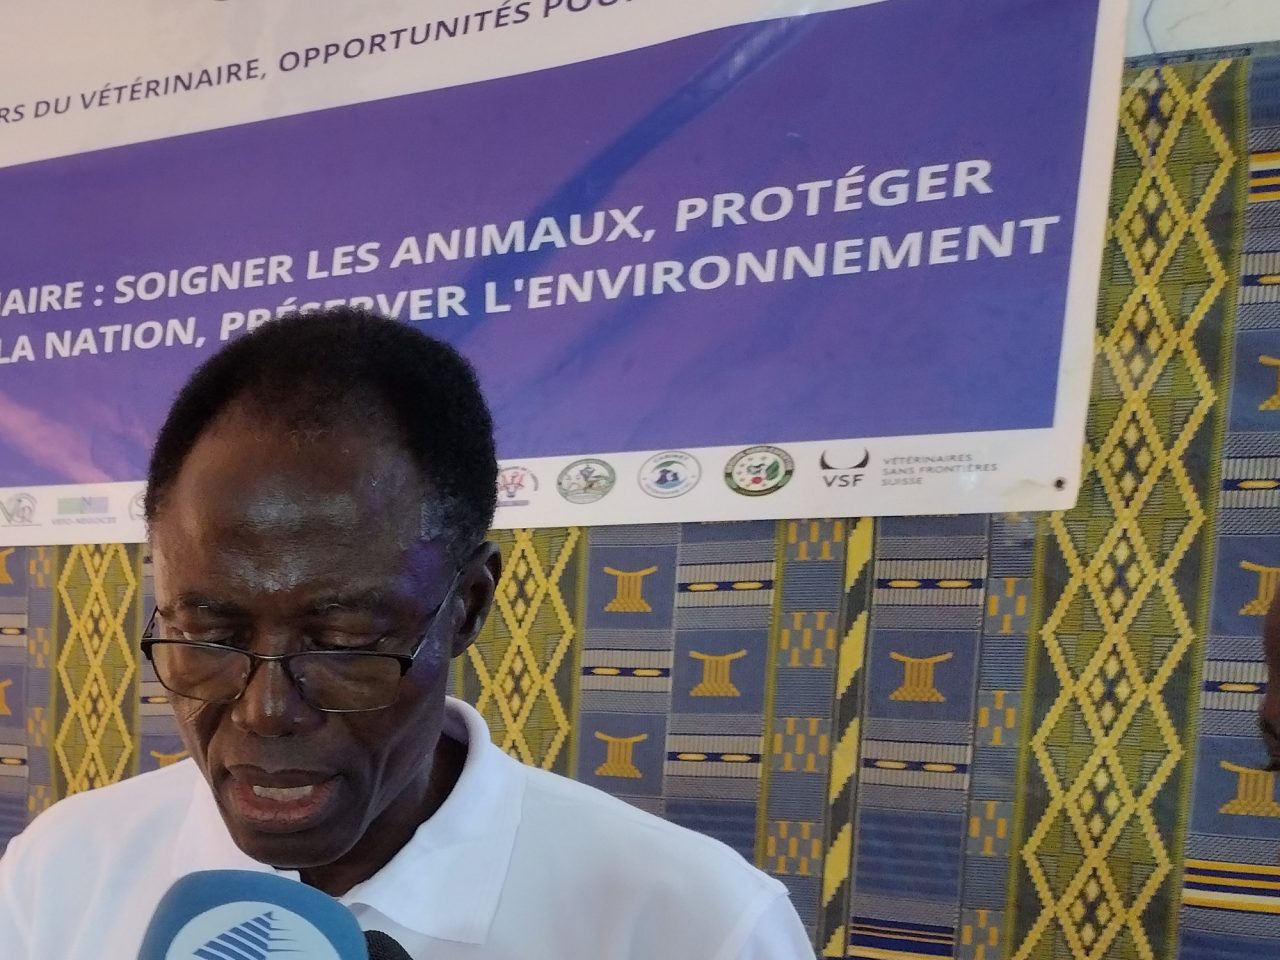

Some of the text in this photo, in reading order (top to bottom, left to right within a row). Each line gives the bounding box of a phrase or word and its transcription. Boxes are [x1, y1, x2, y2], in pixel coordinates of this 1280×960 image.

[33, 96, 71, 118] DU
[80, 58, 267, 110] VÉTÉRINAIRE,
[279, 0, 530, 73] OPPORTUNITÉS
[544, 0, 632, 18] PO
[114, 254, 294, 304] SOIGNER
[306, 241, 381, 280] LES
[390, 205, 656, 269] ANIMAUX,
[675, 159, 993, 233] PROTÉGER
[43, 316, 207, 358] NATION,
[485, 215, 1060, 314] L'ENVIRONNEMENT
[822, 473, 864, 487] VSF
[881, 477, 923, 487] SUISSE
[882, 467, 915, 476] SANS
